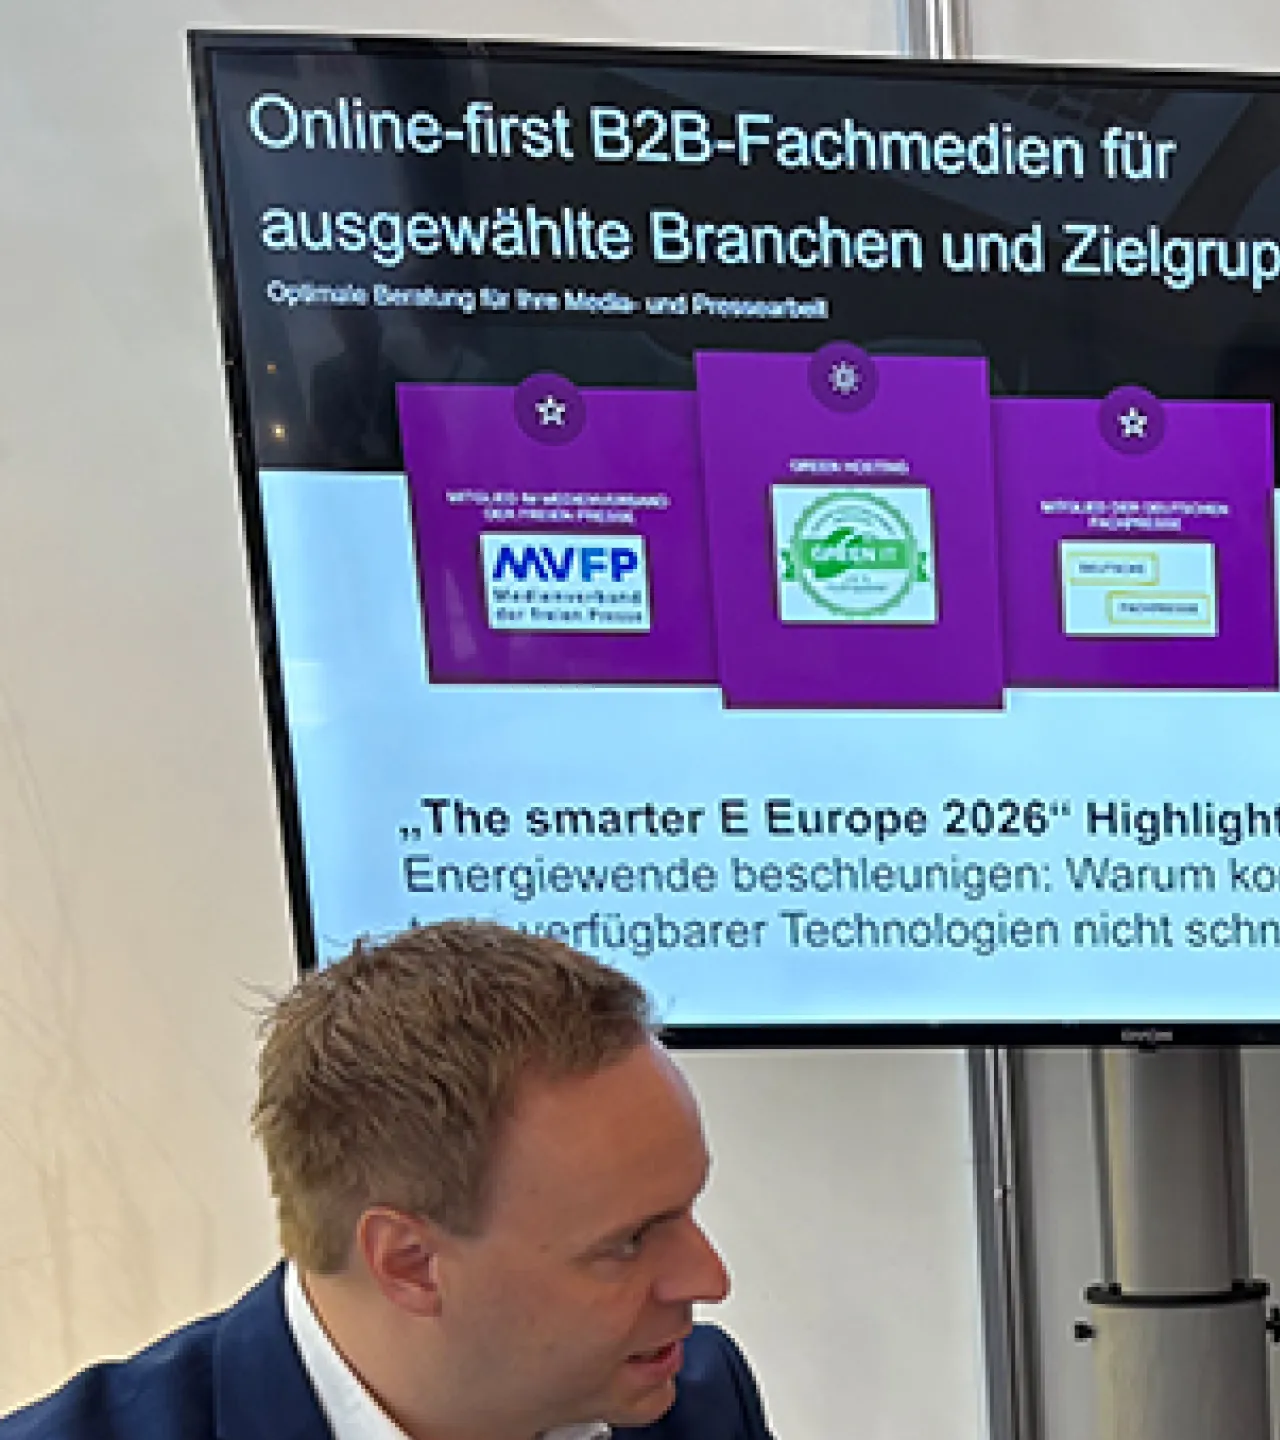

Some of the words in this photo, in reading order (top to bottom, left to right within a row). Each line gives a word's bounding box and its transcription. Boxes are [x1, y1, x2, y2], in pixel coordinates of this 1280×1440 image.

[250, 93, 573, 157] Online-first
[591, 106, 1083, 178] B2B-Fachmedien
[1100, 127, 1176, 178] für
[263, 208, 629, 267] ausgewählte
[650, 212, 922, 268] Branchen
[943, 225, 1045, 272] und
[267, 280, 369, 306] Optimale
[374, 284, 476, 313] Beratung
[480, 288, 510, 310] für
[514, 289, 560, 310] Ihre
[565, 289, 637, 314] Media-
[646, 297, 688, 314] und
[692, 293, 828, 318] Pressearbeit
[491, 546, 639, 582] MVFP
[527, 803, 705, 837] smarter
[722, 799, 748, 833] E
[765, 799, 926, 844] Europe
[943, 799, 1070, 836] 2026“
[403, 854, 718, 902] Energiewende
[731, 858, 1049, 901] beschleunigen:
[1066, 858, 1215, 892] Warum
[778, 909, 1058, 956] Technologien
[1075, 913, 1173, 947] nicht
